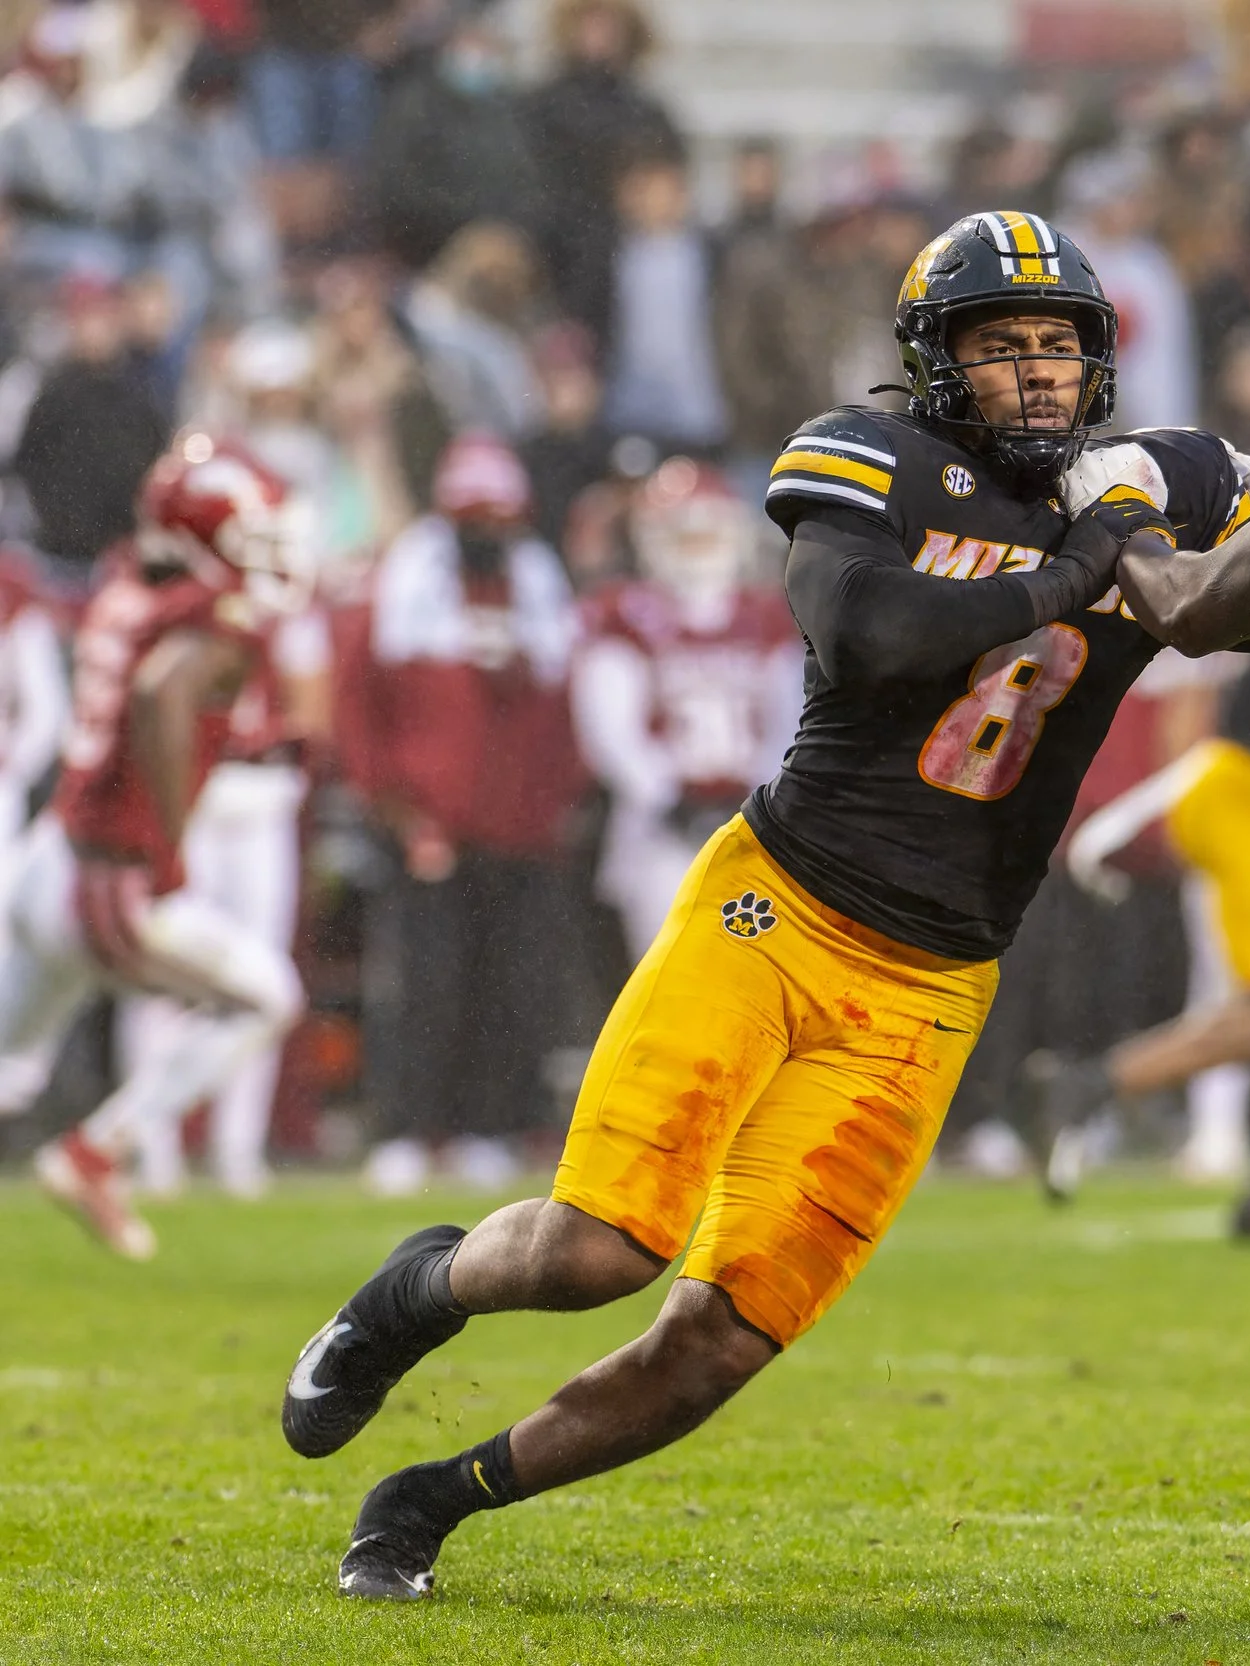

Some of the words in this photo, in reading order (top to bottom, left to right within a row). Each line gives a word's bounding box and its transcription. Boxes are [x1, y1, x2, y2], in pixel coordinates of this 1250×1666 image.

[1011, 274, 1059, 285] MIZZOU
[945, 466, 974, 495] SEC
[917, 621, 1089, 801] 8
[728, 916, 754, 937] M
